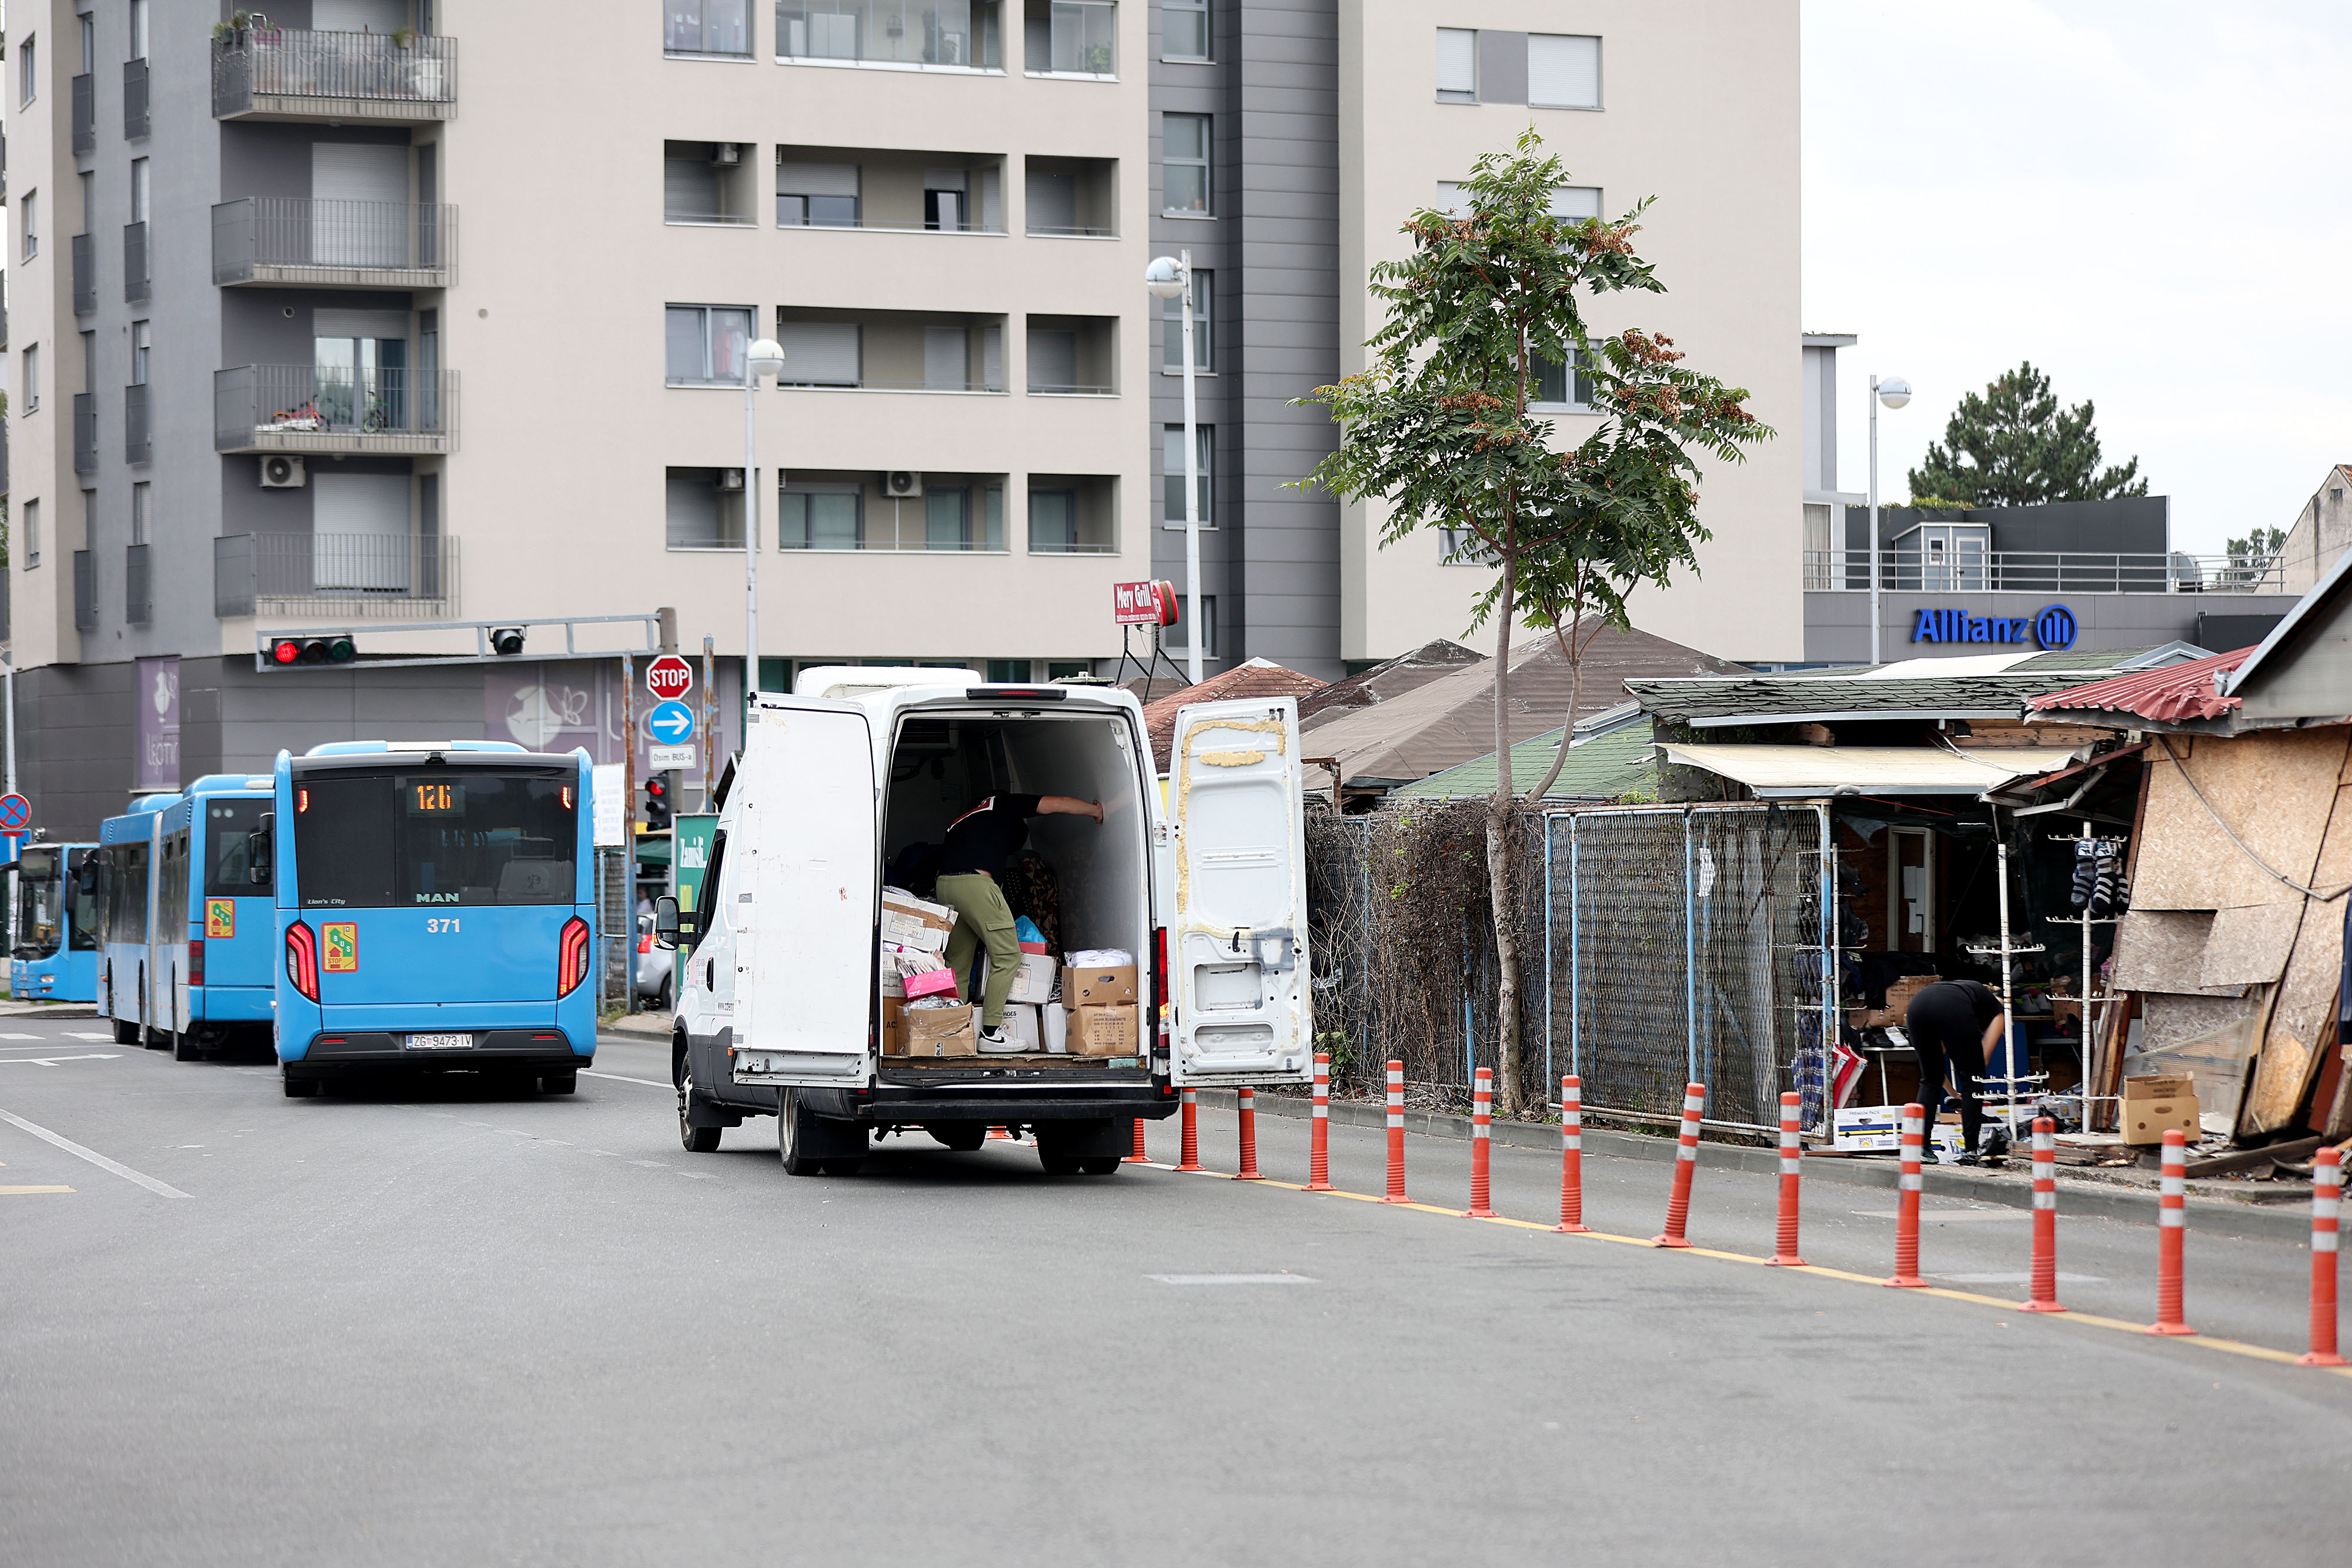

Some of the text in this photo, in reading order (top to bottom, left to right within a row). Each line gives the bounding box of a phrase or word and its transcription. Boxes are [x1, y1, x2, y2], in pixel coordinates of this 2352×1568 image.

[1134, 584, 1152, 607] Grill
[1912, 609, 2029, 643] Allianz
[650, 668, 688, 687] STOP
[416, 785, 452, 810] 126
[416, 893, 459, 903] MAN
[427, 918, 460, 933] 371
[333, 935, 351, 952] BUS
[414, 1037, 426, 1047] ZG
